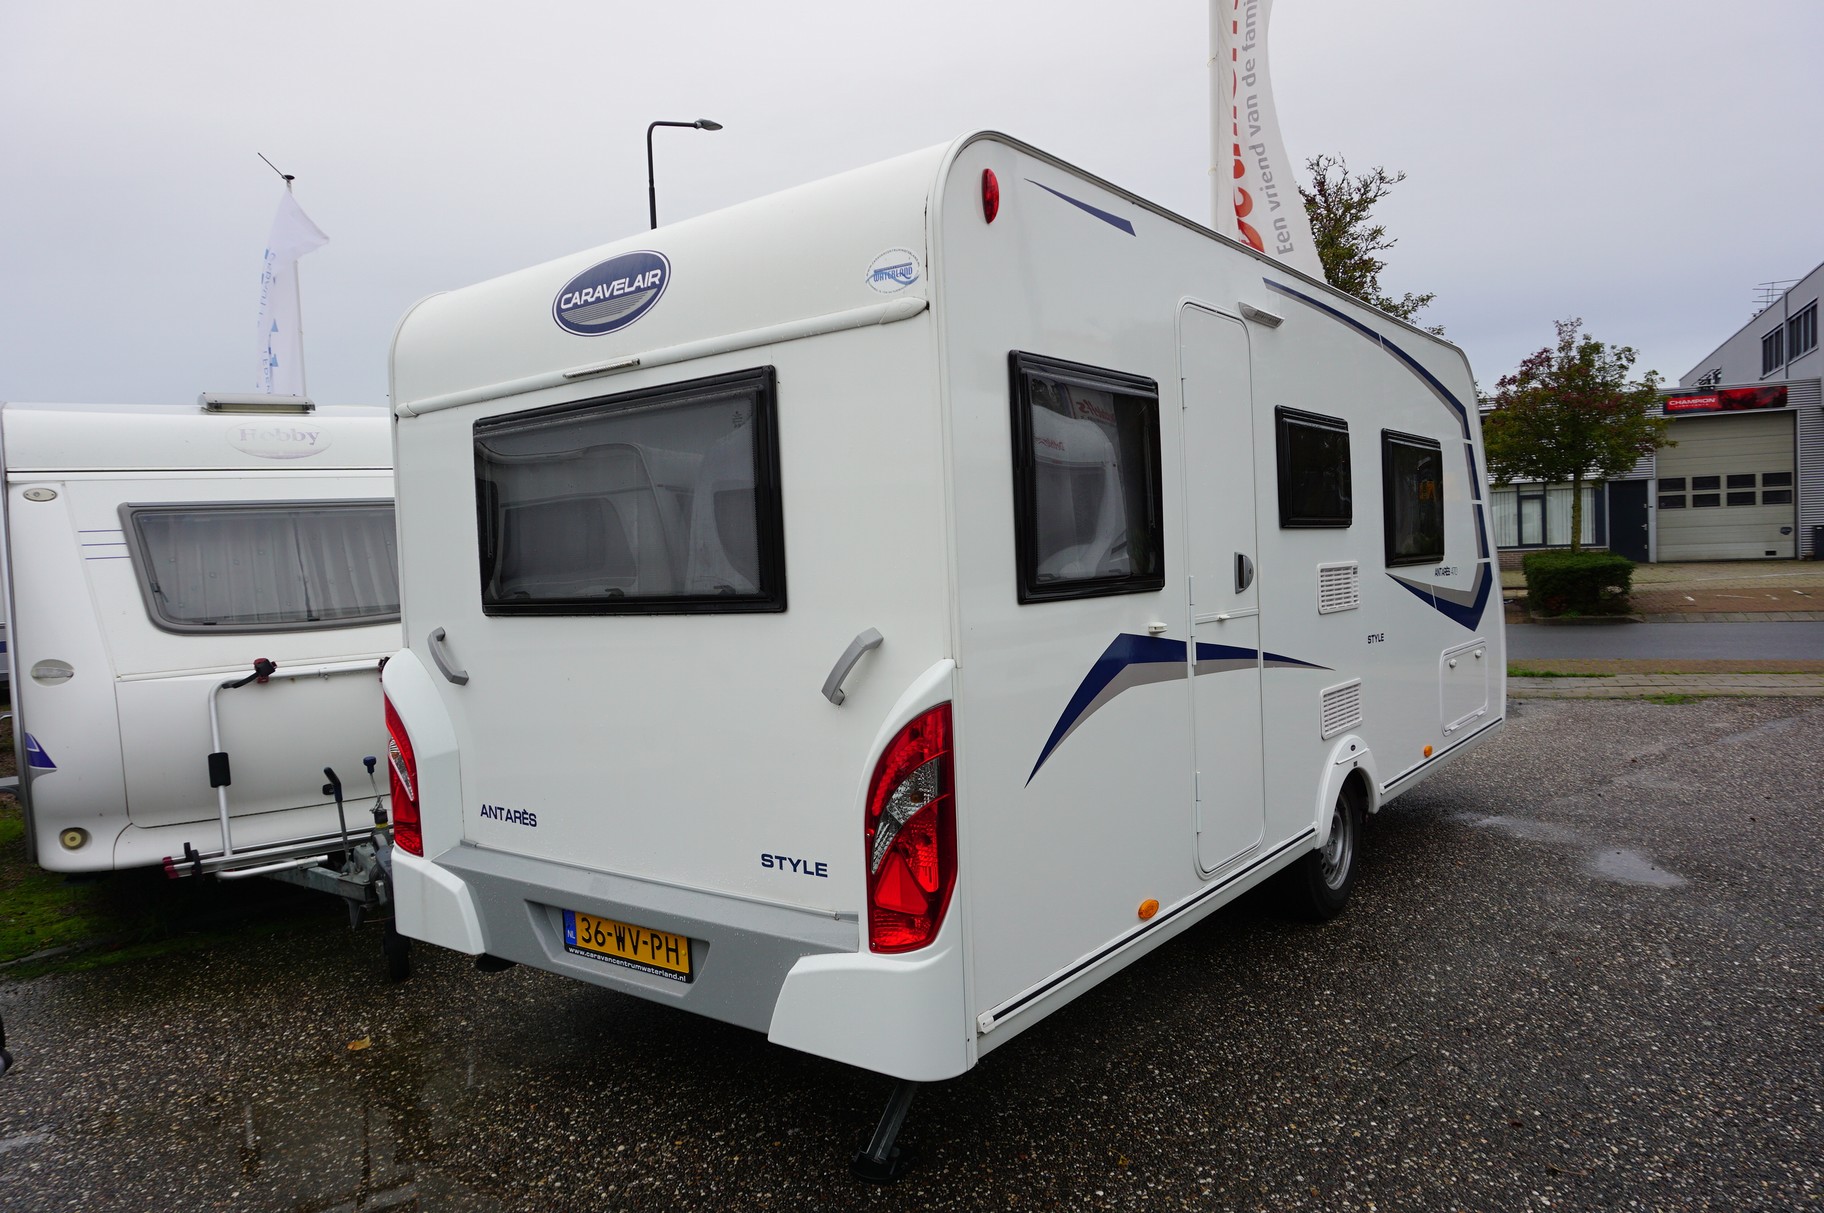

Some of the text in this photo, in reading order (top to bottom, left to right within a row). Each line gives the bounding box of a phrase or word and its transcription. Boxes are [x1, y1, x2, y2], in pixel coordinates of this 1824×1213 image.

[1241, 58, 1256, 87] de
[1246, 94, 1261, 137] van
[1248, 142, 1281, 212] vriend
[1276, 217, 1294, 255] Een
[561, 269, 662, 309] CARAVELAIR
[239, 428, 320, 446] Hobby
[1367, 633, 1385, 644] STYLE
[480, 804, 537, 828] ANTARÈS
[761, 853, 828, 878] STYLE
[567, 930, 576, 939] NL
[581, 917, 680, 966] 36-WV-PH
[568, 947, 686, 982] www.caravancentrumwaterland.nl
